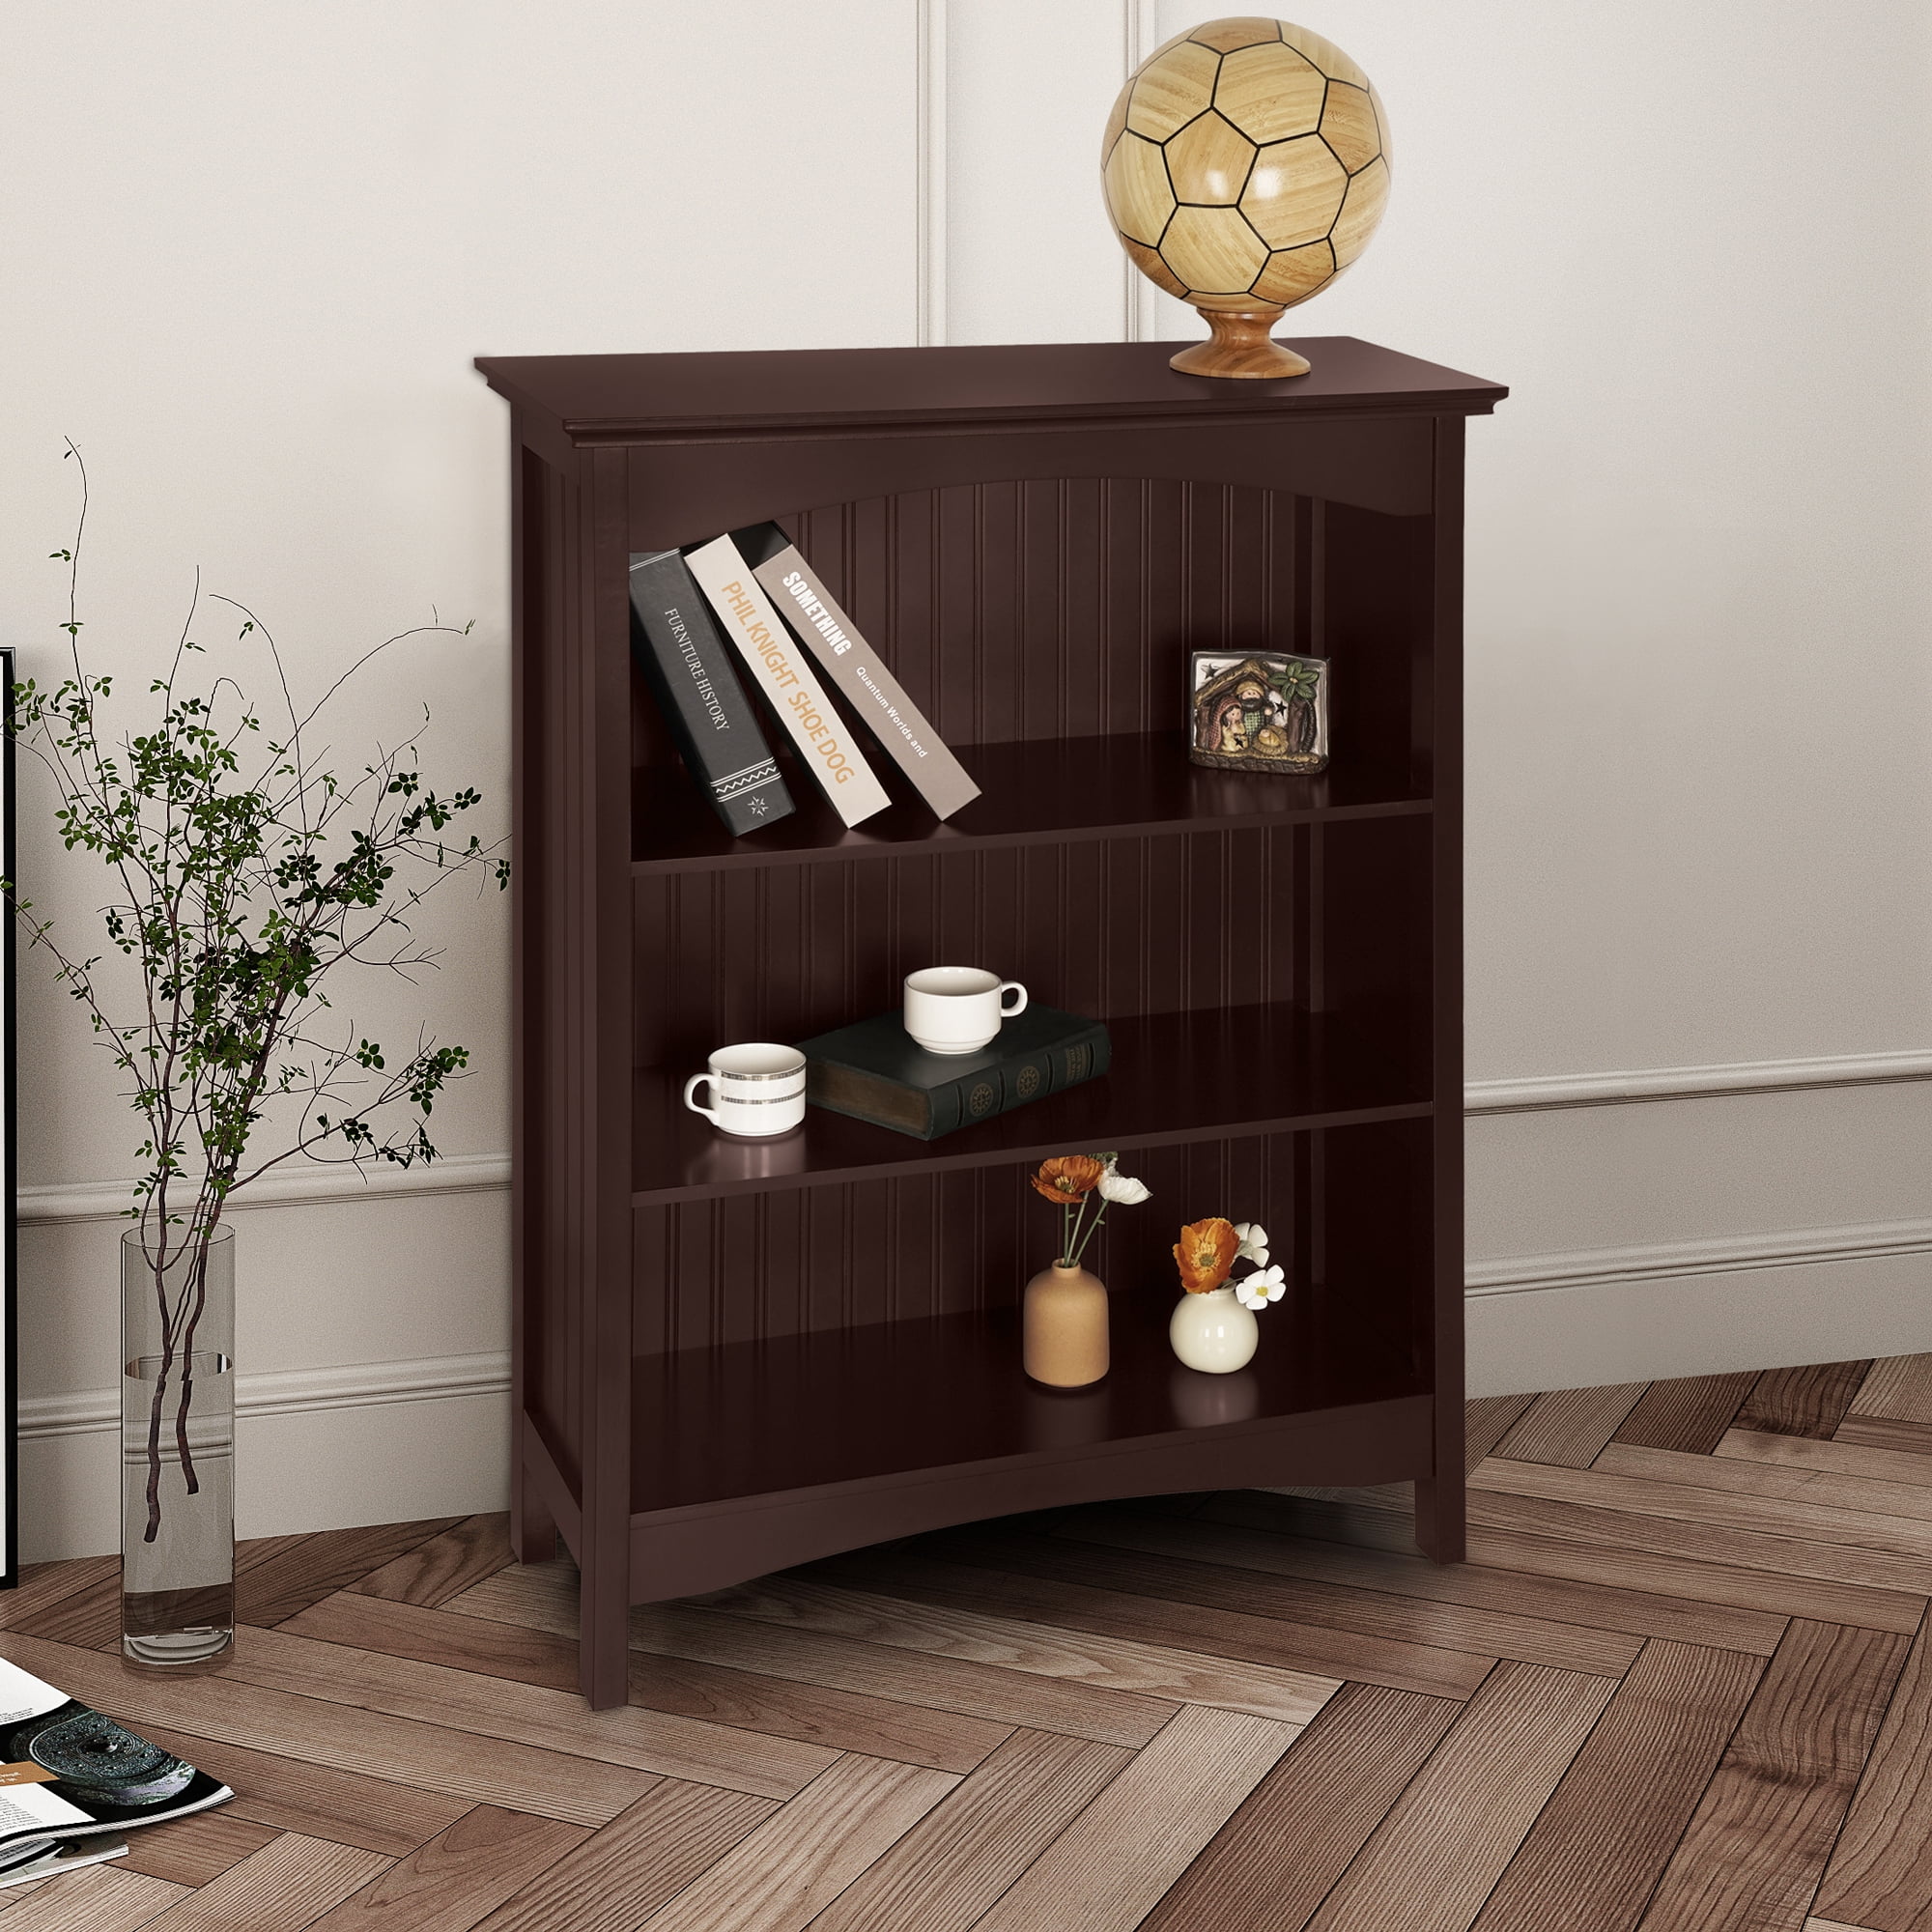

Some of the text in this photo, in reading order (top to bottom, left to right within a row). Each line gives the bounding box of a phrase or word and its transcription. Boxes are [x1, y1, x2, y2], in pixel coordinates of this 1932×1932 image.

[782, 571, 852, 657] SOMETHING
[665, 608, 730, 730] FURNITURE HISTORY
[721, 581, 855, 784] PHIL KNIGHT SHOE DOG
[856, 666, 928, 758] Quantum Worlds and
